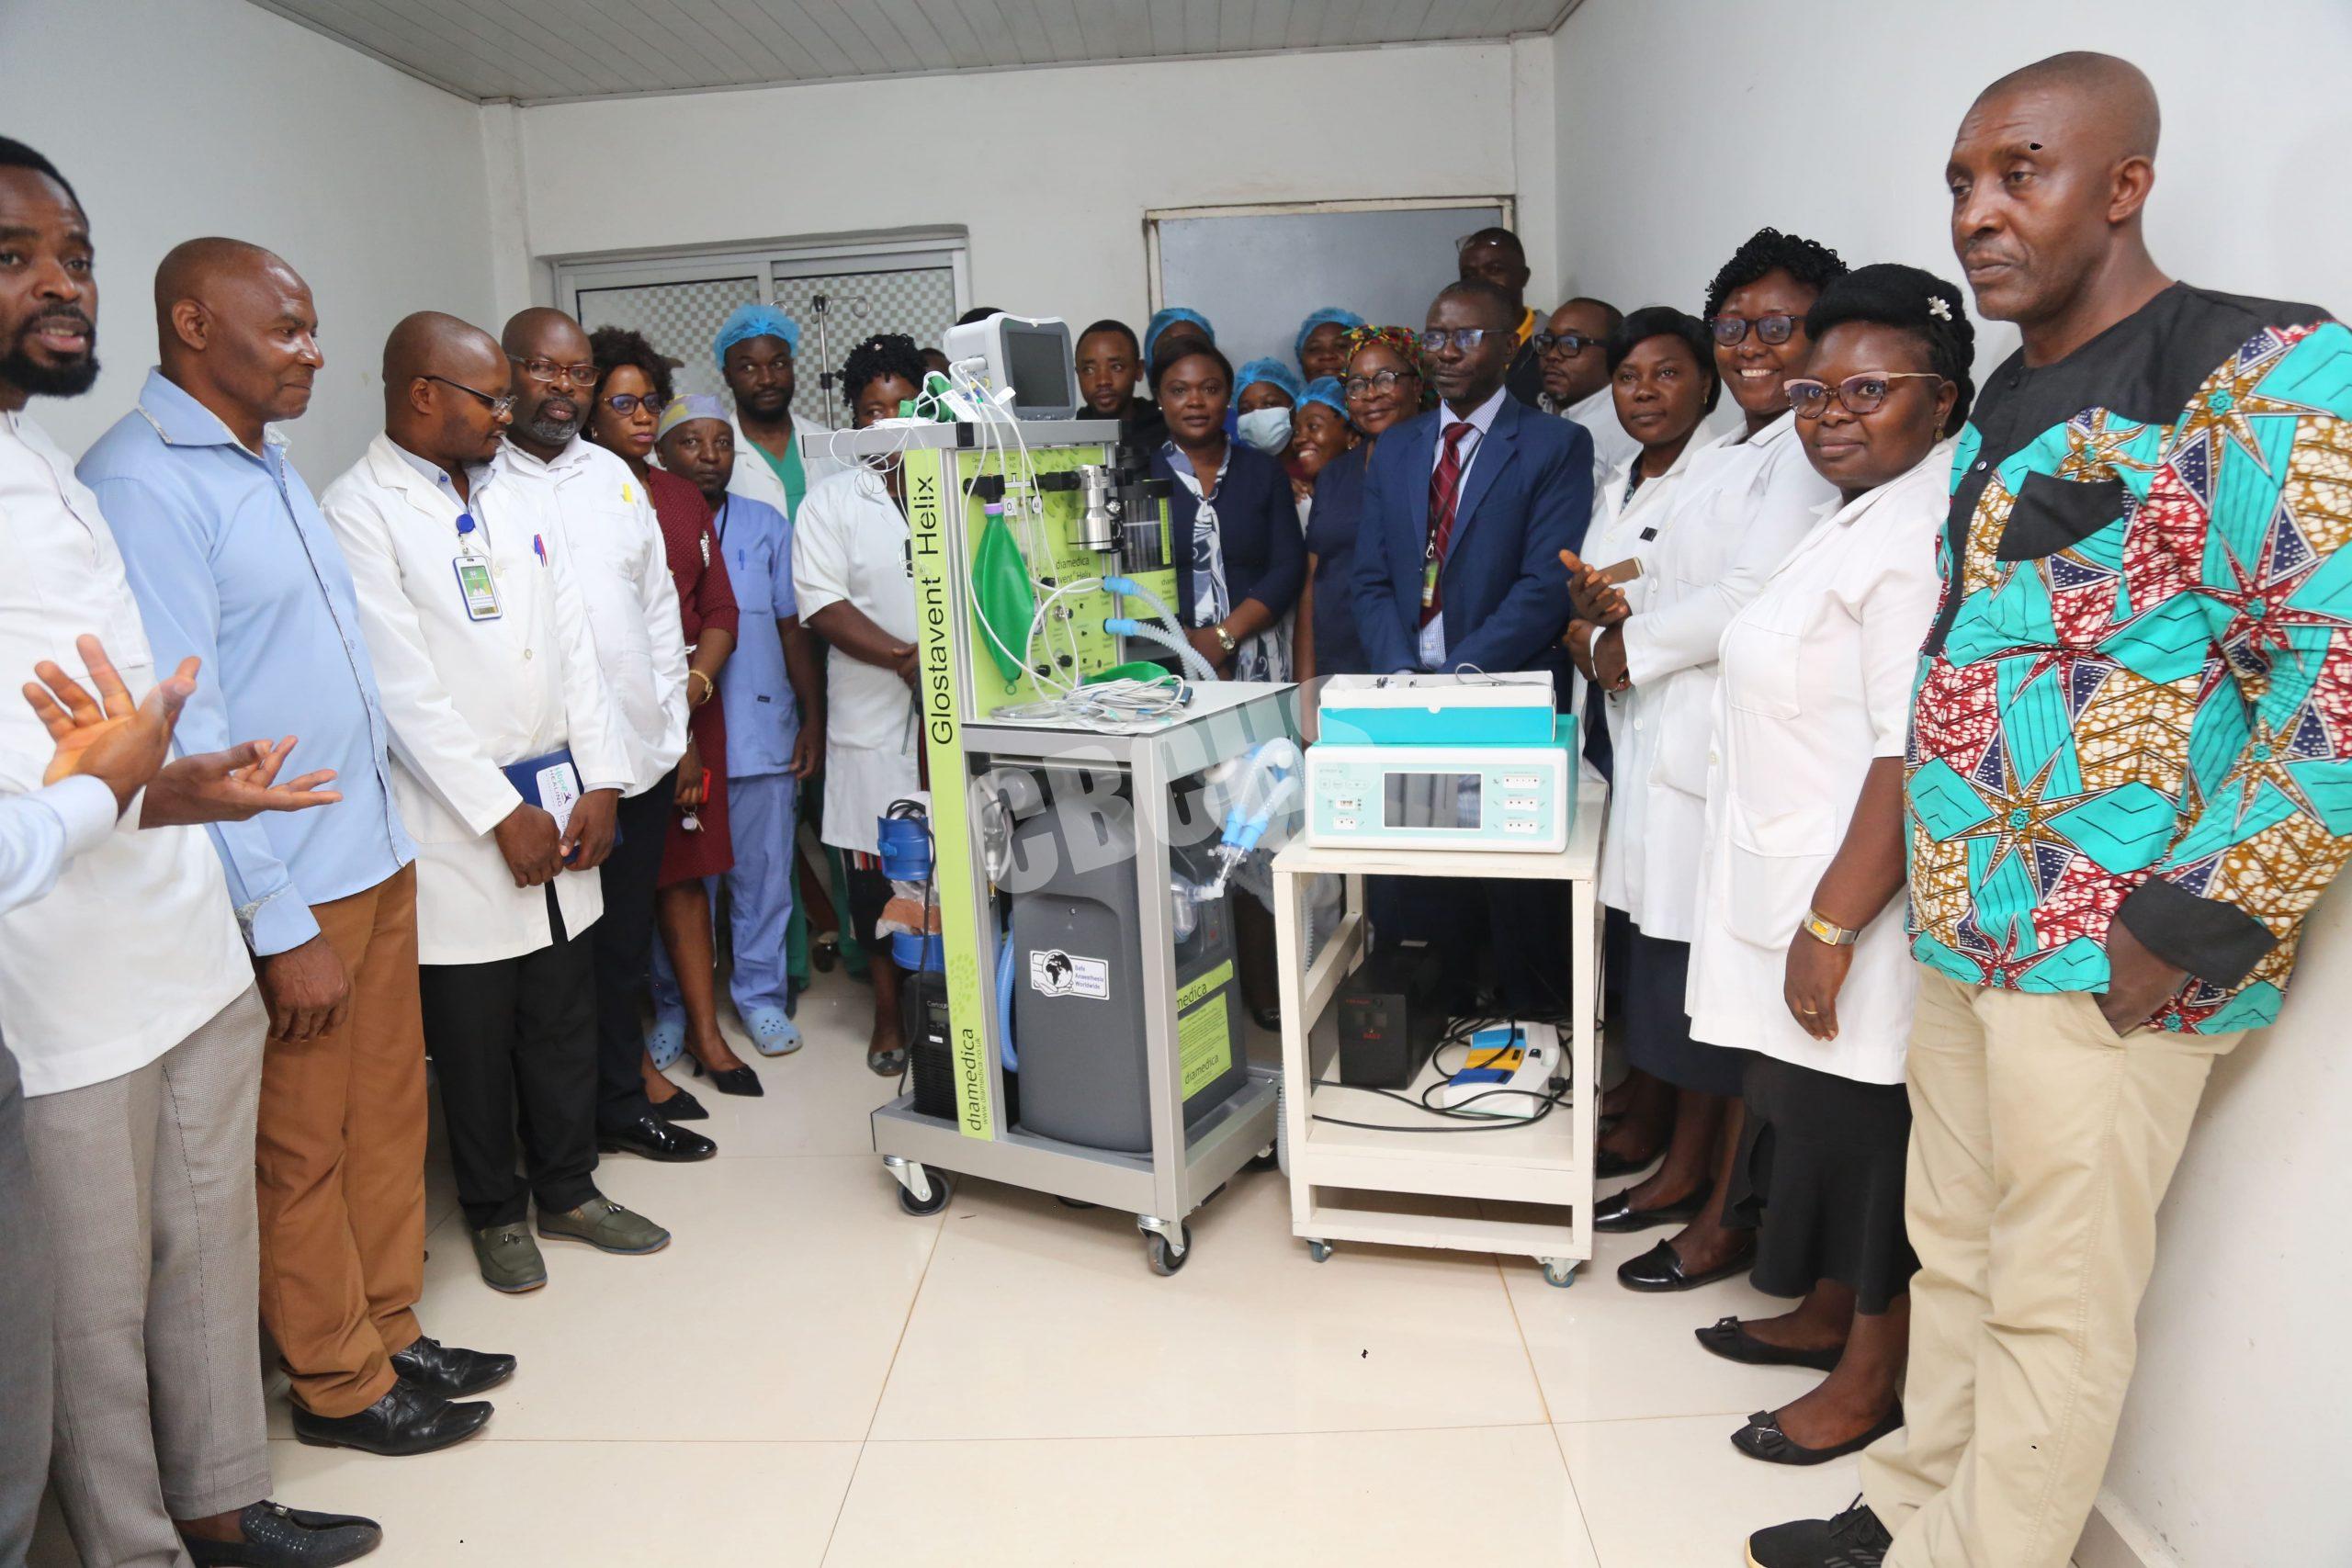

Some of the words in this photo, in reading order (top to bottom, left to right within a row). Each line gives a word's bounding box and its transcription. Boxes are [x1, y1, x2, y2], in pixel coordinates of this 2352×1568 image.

[913, 476, 939, 555] Helix
[1056, 555, 1090, 570] diamedica
[921, 576, 954, 745] Glostavent
[549, 770, 563, 807] HEALING
[1075, 974, 1104, 982] Anaesthesia
[1075, 982, 1101, 990] Worldwide
[1176, 983, 1207, 1010] medica
[960, 1028, 982, 1132] diamedica
[976, 1037, 989, 1125] www.diamedica.co.uk
[1184, 1054, 1219, 1085] diamedica
